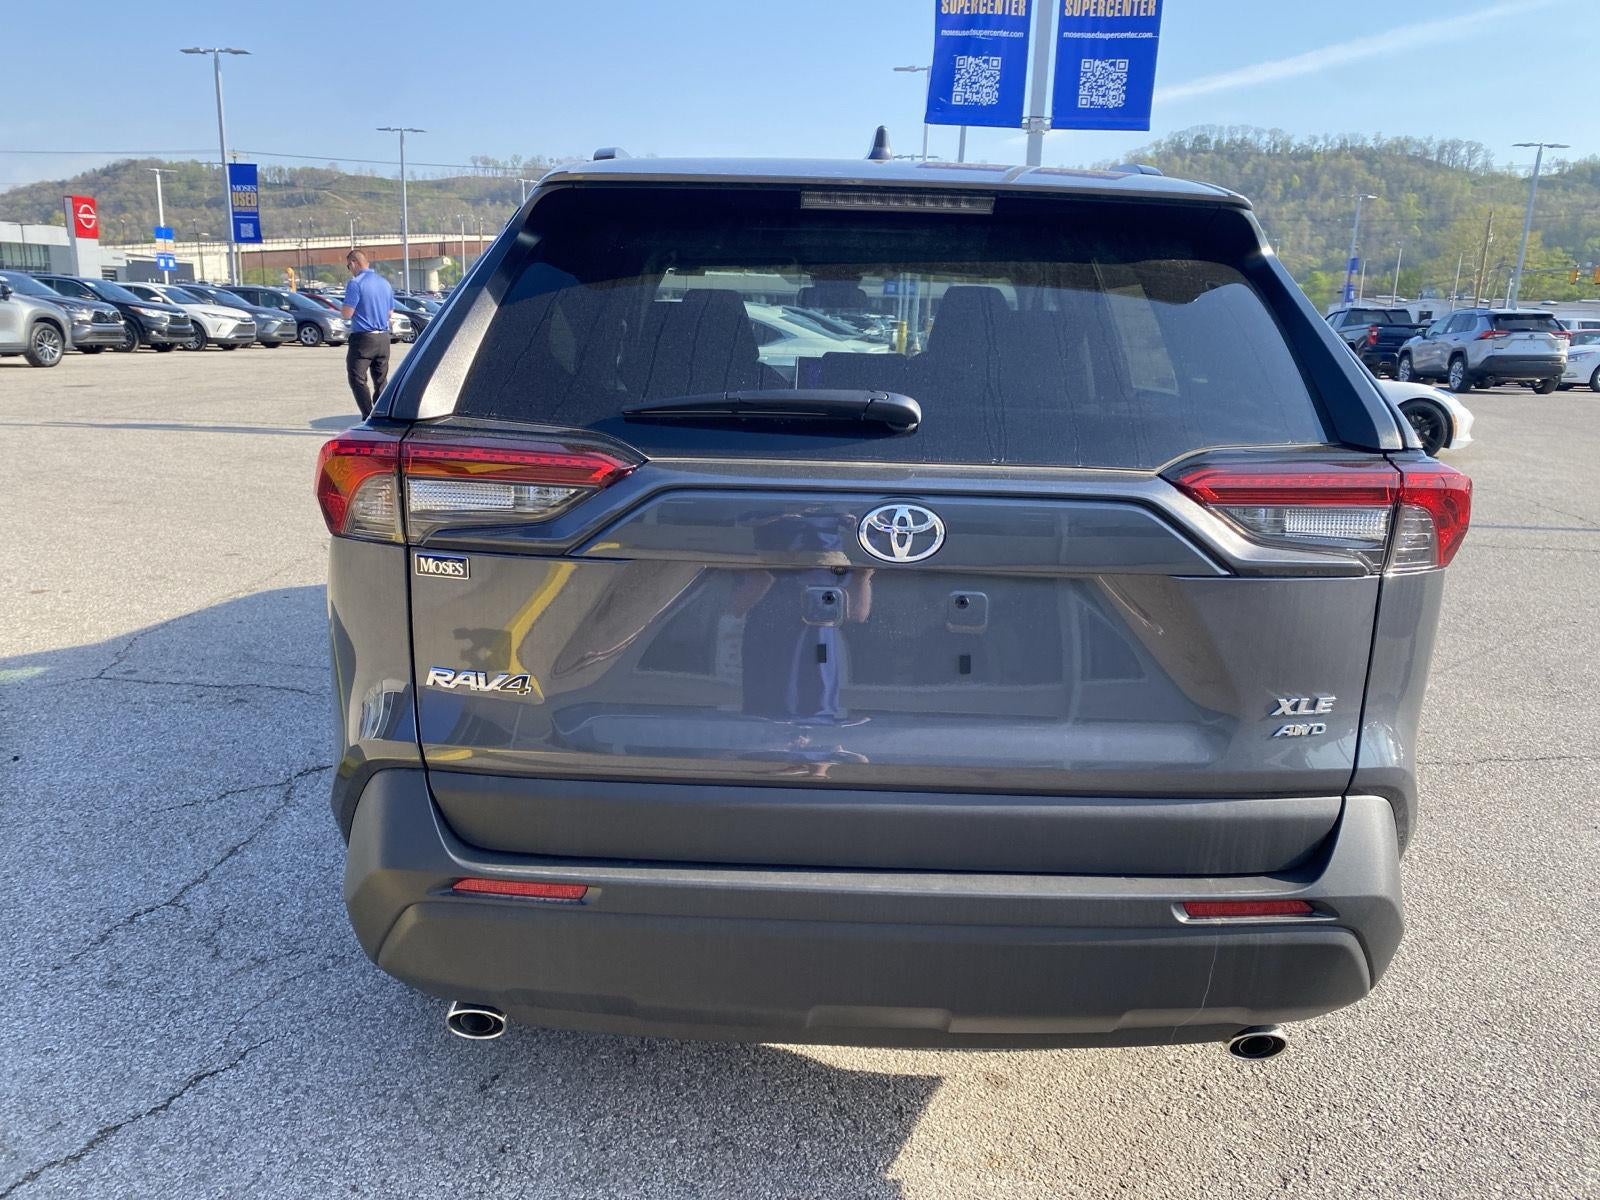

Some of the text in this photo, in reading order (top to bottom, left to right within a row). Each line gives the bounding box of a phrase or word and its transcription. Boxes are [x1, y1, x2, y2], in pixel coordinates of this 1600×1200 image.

[941, 0, 1026, 16] SUPERCENTER
[1064, 0, 1156, 17] SUPERCENTER
[941, 28, 1024, 38] mosesusedsupercenter.com
[1063, 31, 1153, 40] mosesusedsupercenter.com
[232, 184, 257, 192] MOSES
[232, 192, 257, 207] USED
[419, 557, 464, 576] MOSES
[425, 666, 532, 696] RAV4
[1270, 696, 1337, 716] XLE
[1272, 723, 1327, 737] AWD
